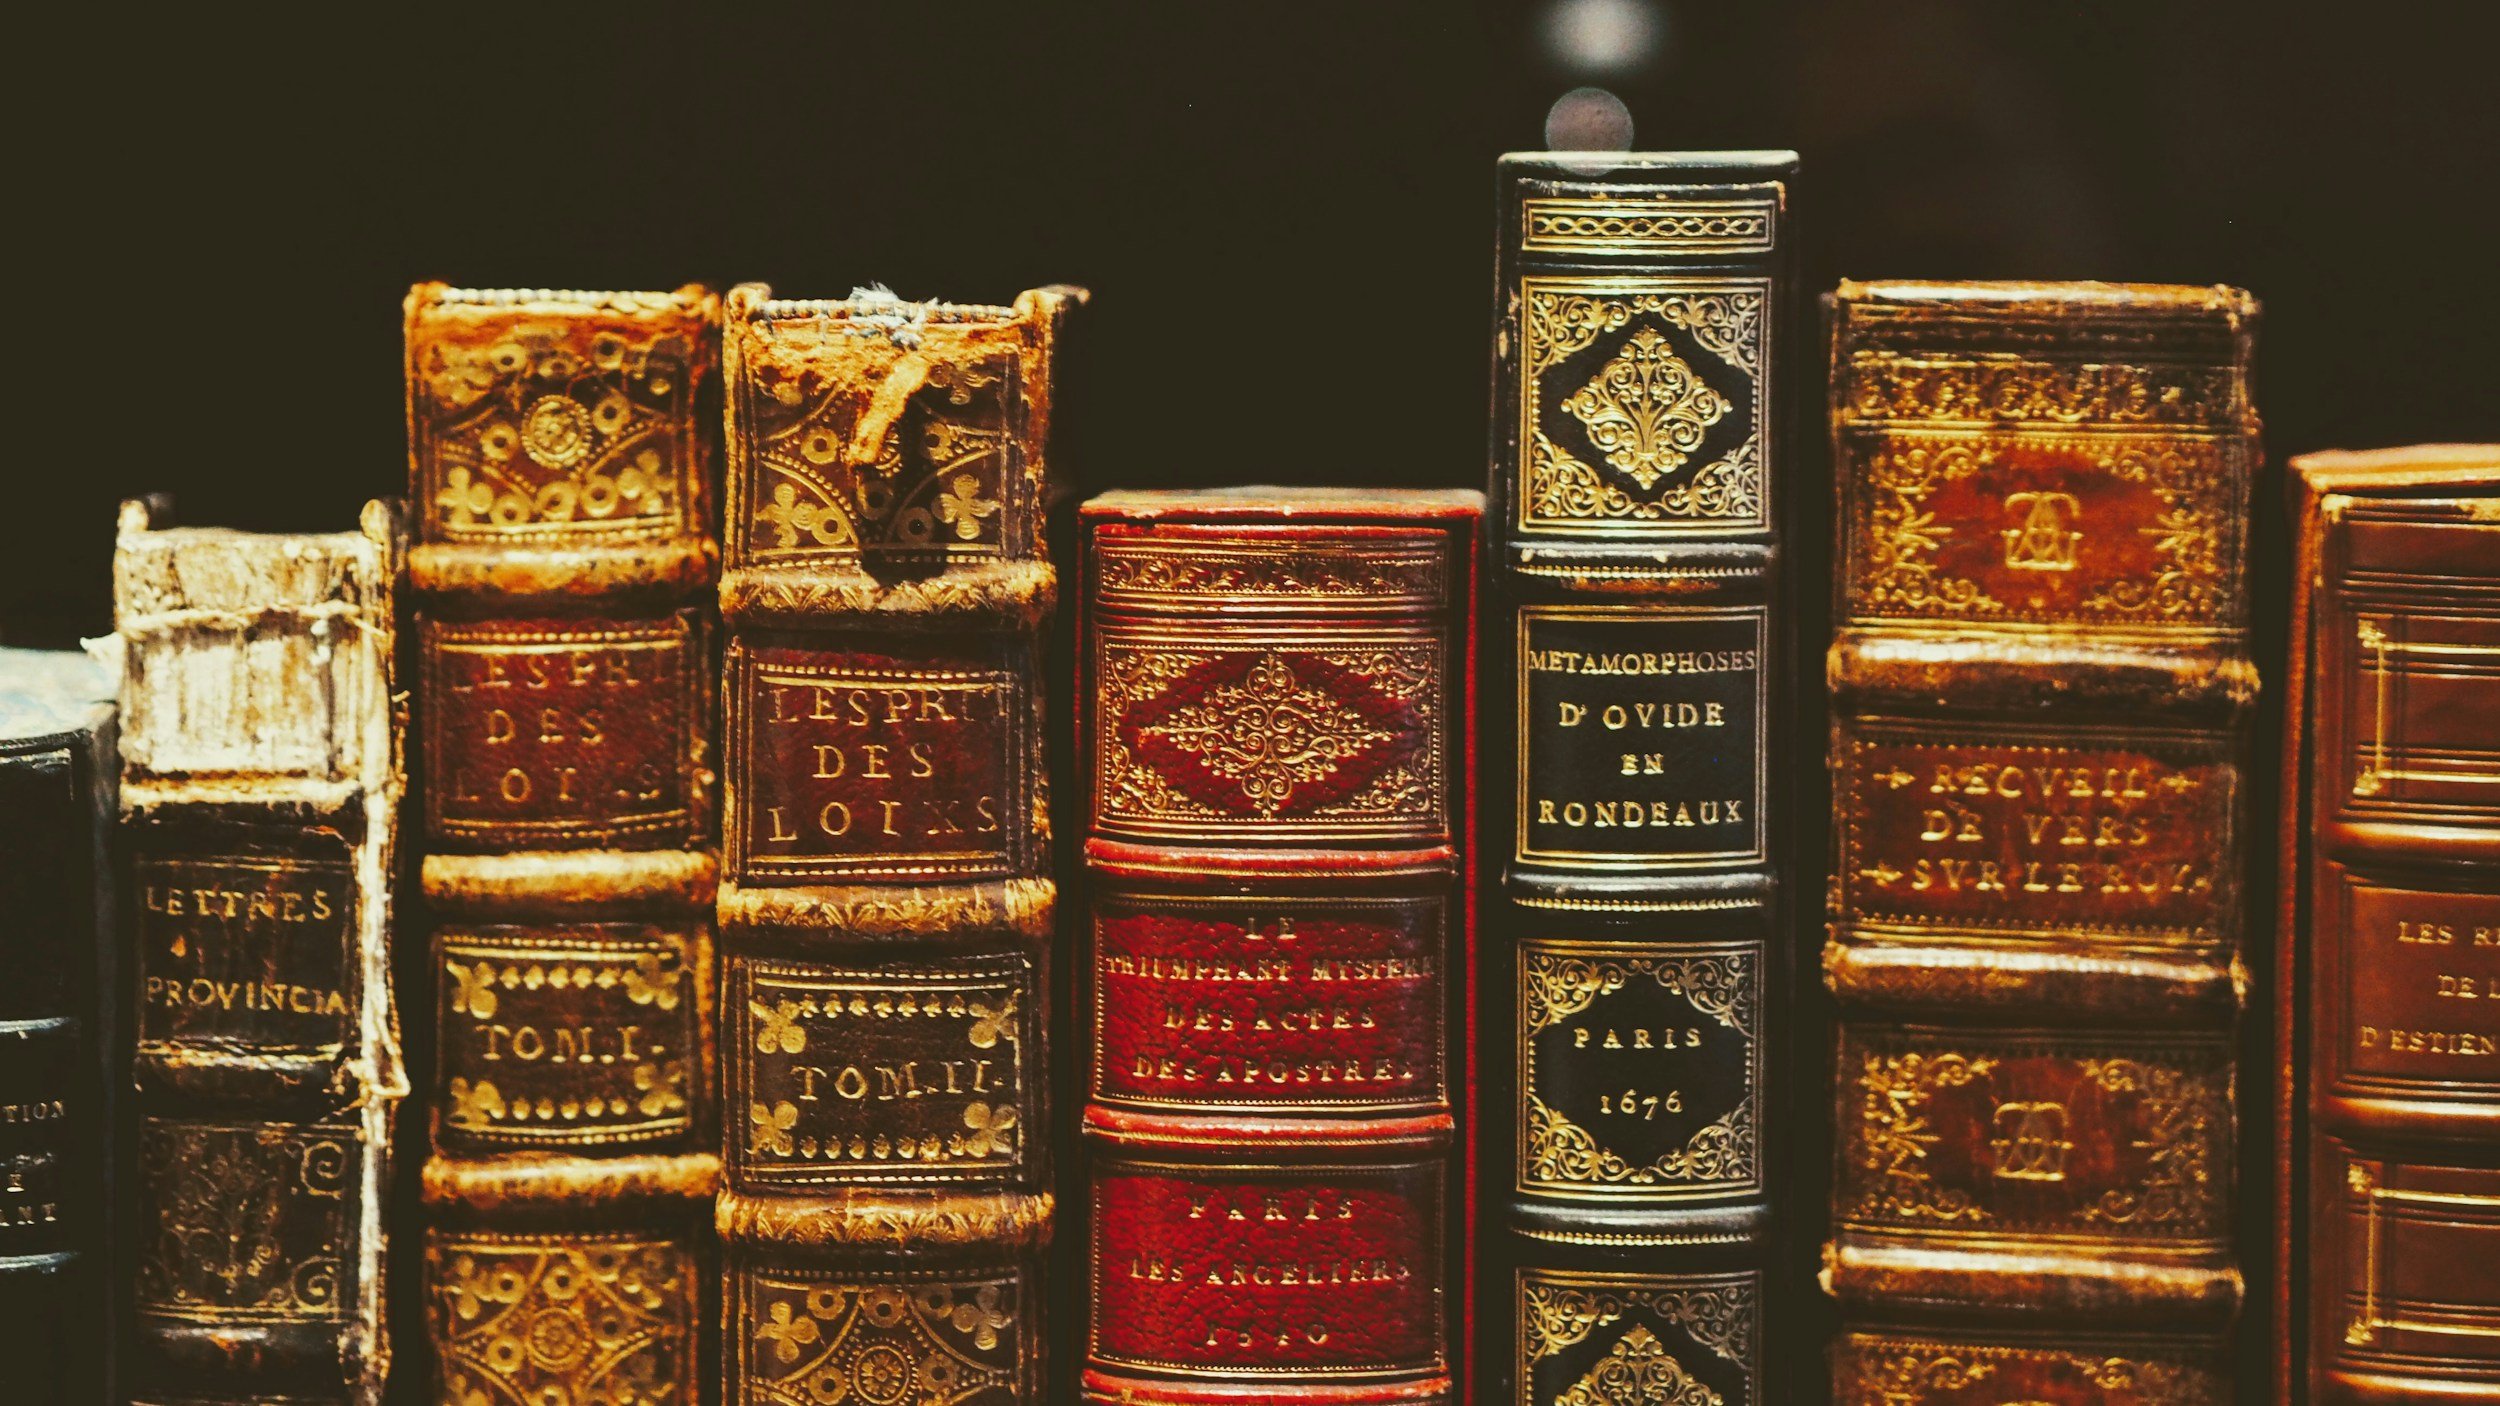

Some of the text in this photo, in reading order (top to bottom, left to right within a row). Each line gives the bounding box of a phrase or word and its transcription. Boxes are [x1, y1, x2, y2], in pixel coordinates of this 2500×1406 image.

[1529, 650, 1756, 676] METAMORPHOSES
[485, 709, 602, 745] DES
[811, 743, 934, 779] DES
[1620, 753, 1665, 776] EN
[1537, 800, 1744, 828] RONDEAUX
[1920, 809, 2149, 846] DE VERS
[2397, 920, 2500, 946] LES R
[2437, 974, 2479, 999] DE
[1573, 1027, 1701, 1049] PARIS
[1600, 1089, 1683, 1121] 1676
